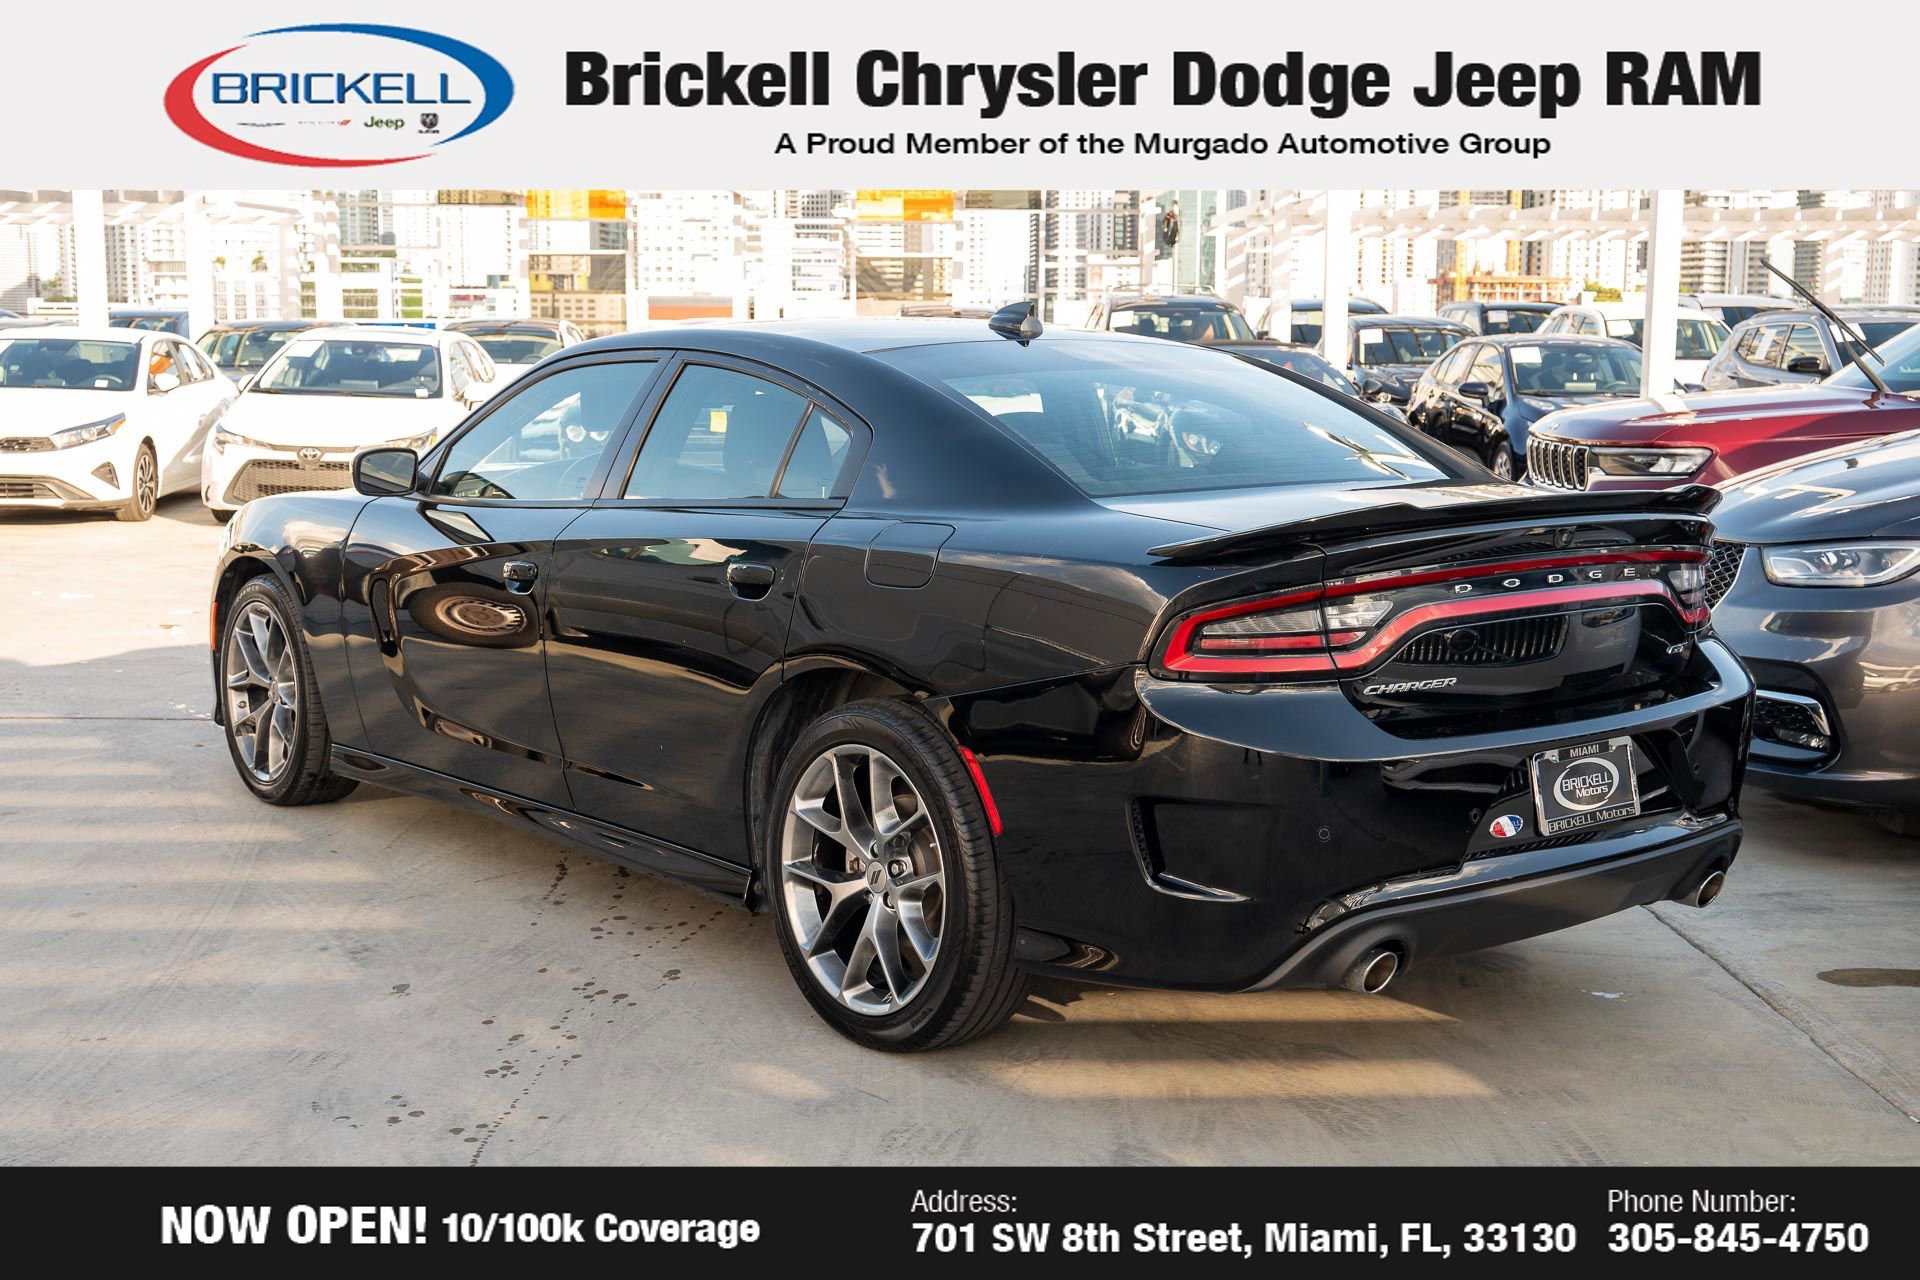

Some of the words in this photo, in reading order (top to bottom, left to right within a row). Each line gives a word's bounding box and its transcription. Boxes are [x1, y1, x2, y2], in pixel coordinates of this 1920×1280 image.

[1454, 566, 1636, 594] DODGE
[1363, 676, 1458, 697] CHARGER
[1569, 743, 1600, 758] MIAMI
[1562, 772, 1613, 792] BRICKELL
[1575, 784, 1609, 799] Motors
[1548, 815, 1595, 833] BRICKELL
[1596, 805, 1636, 822] Motors
